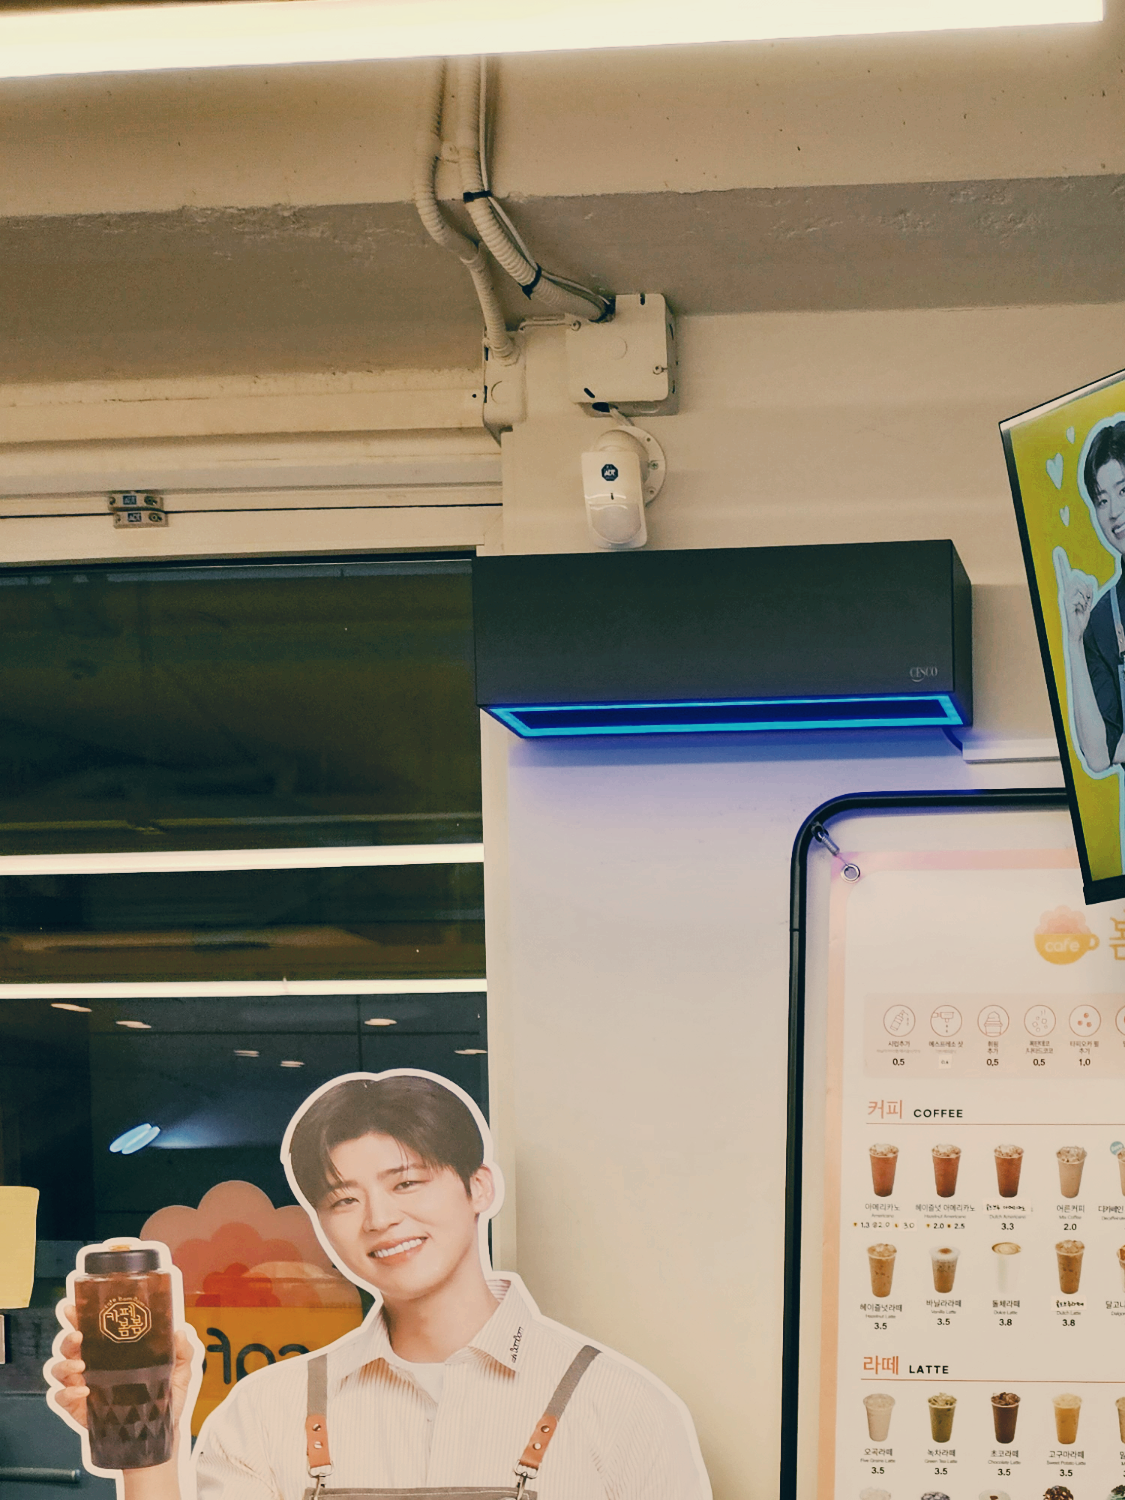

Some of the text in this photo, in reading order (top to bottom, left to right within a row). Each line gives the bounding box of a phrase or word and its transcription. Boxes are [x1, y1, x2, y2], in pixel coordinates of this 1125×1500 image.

[1045, 938, 1080, 952] cafe
[868, 1100, 963, 1119] 커피 COFFEE
[863, 1355, 949, 1375] 라떼 LATTE
[1049, 1450, 1084, 1460] 고구마라떼
